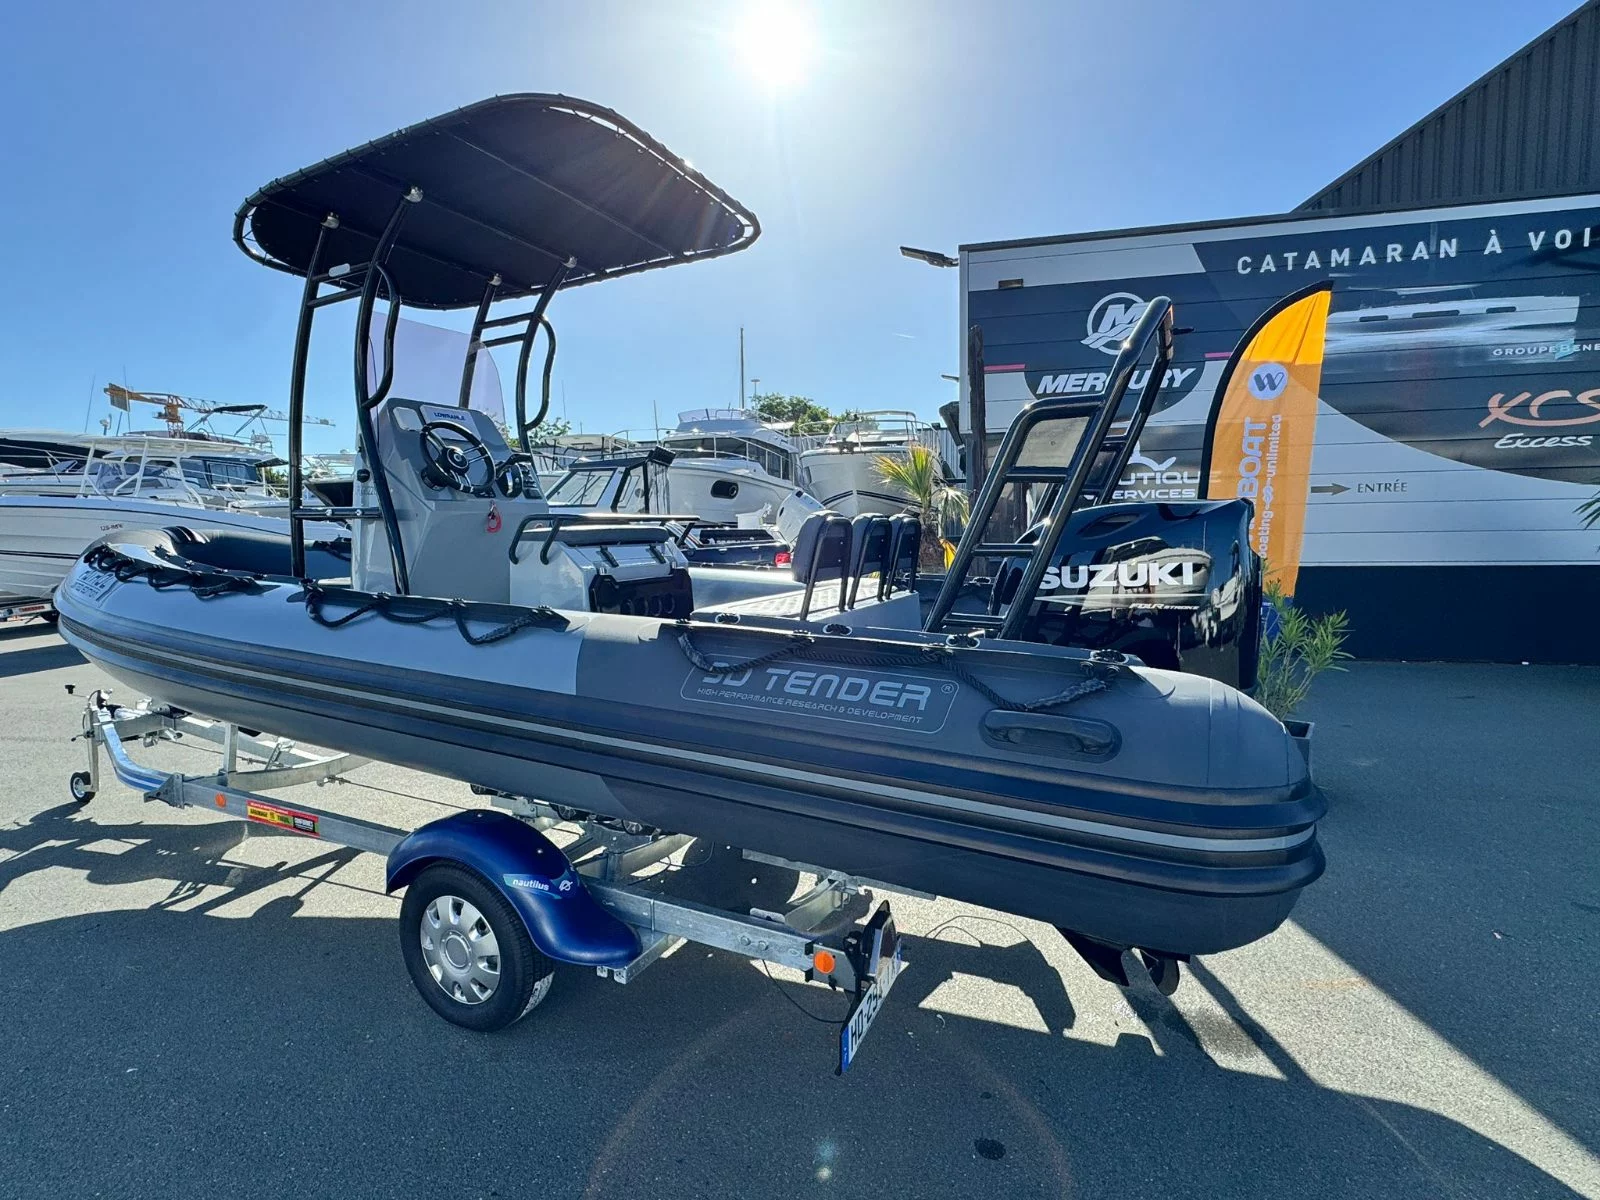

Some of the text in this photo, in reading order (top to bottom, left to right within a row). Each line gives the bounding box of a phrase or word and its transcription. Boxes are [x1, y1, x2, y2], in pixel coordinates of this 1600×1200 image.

[1237, 227, 1591, 275] CATAMARAN À VOI
[1036, 368, 1196, 394] MERURY
[1266, 414, 1282, 478] unlimited
[1494, 433, 1593, 449] Excess
[1112, 489, 1196, 500] ERVICES
[1357, 479, 1408, 494] ENTRÉE
[1039, 562, 1194, 590] SUZUKI
[765, 667, 931, 711] TENDER
[697, 688, 717, 697] HIGH
[717, 690, 784, 706] PERFORMANCE
[785, 698, 837, 712] RESEARCH
[847, 707, 923, 724] DEVELOPMENT
[512, 879, 549, 891] nautilus
